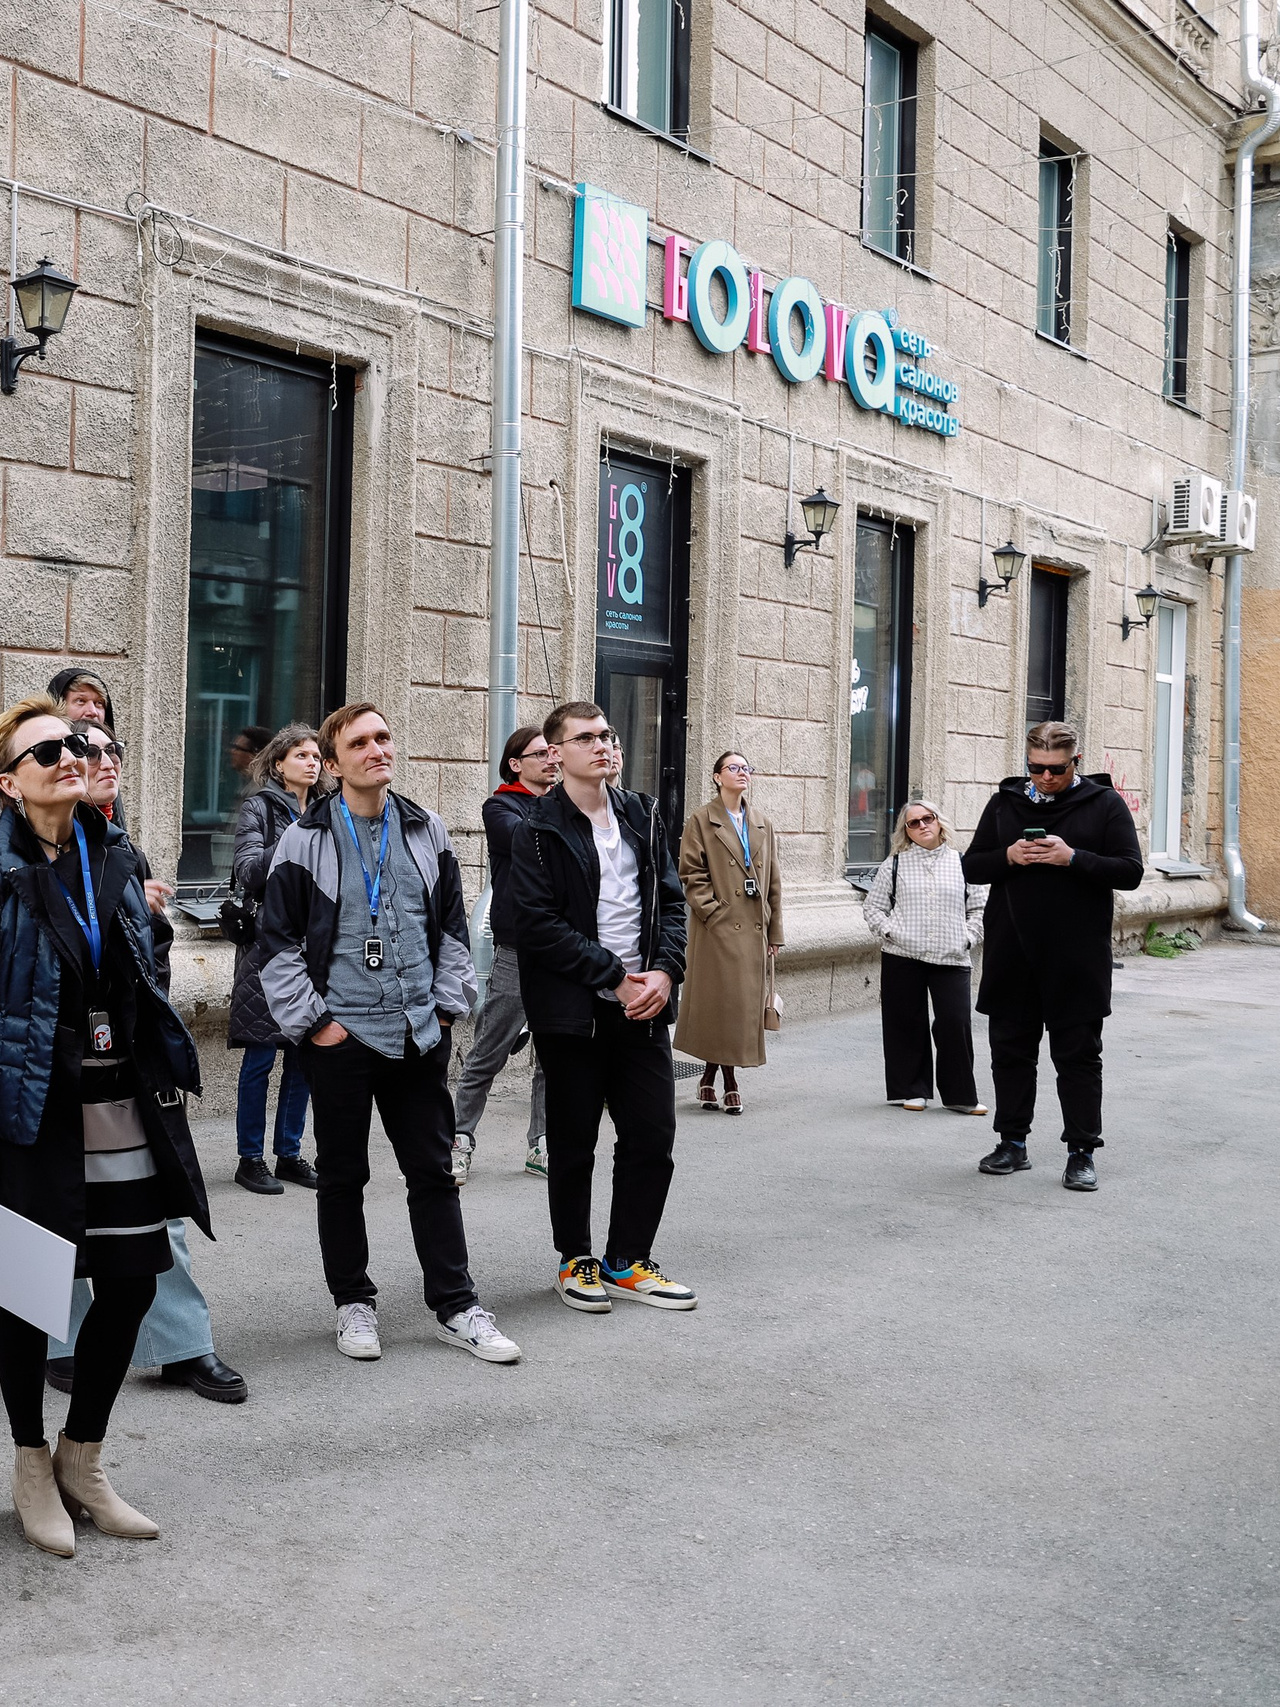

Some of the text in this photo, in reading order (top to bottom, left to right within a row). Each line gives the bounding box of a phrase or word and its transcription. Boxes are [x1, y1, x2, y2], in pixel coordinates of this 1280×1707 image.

[900, 327, 932, 358] сеть
[900, 362, 960, 403] салонов
[900, 396, 959, 437] красоты
[605, 609, 643, 622] сеть салонов
[605, 620, 629, 630] красоты
